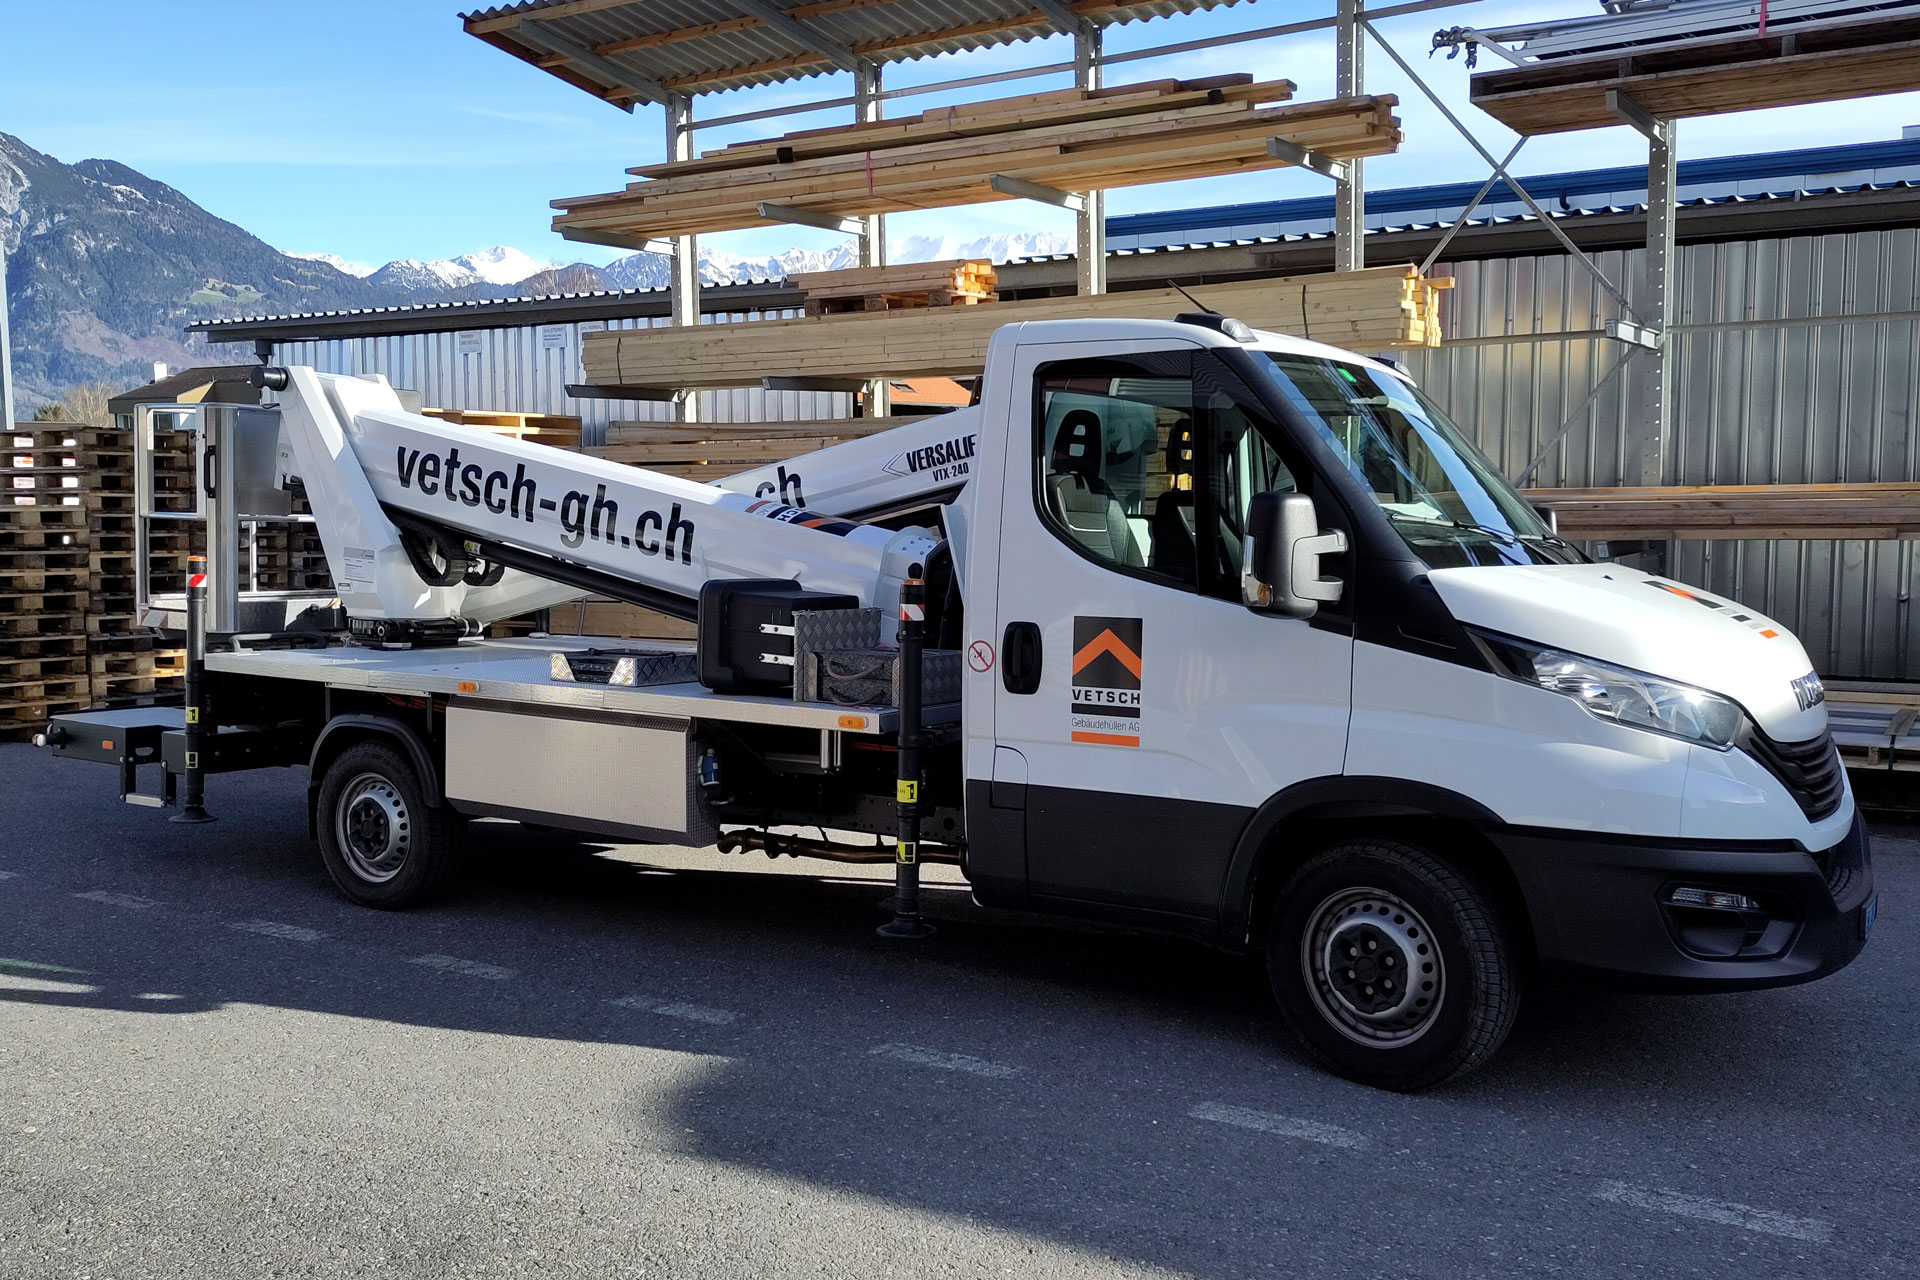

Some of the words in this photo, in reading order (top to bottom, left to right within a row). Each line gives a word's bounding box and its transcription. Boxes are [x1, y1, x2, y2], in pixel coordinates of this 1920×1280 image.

[906, 434, 977, 473] VERSALIF
[932, 462, 969, 483] VTX-240
[397, 446, 696, 567] vetsch-gh.ch
[1072, 689, 1140, 704] VETSCH
[1072, 717, 1126, 731] Gebäudehüllen
[1129, 721, 1140, 732] AG
